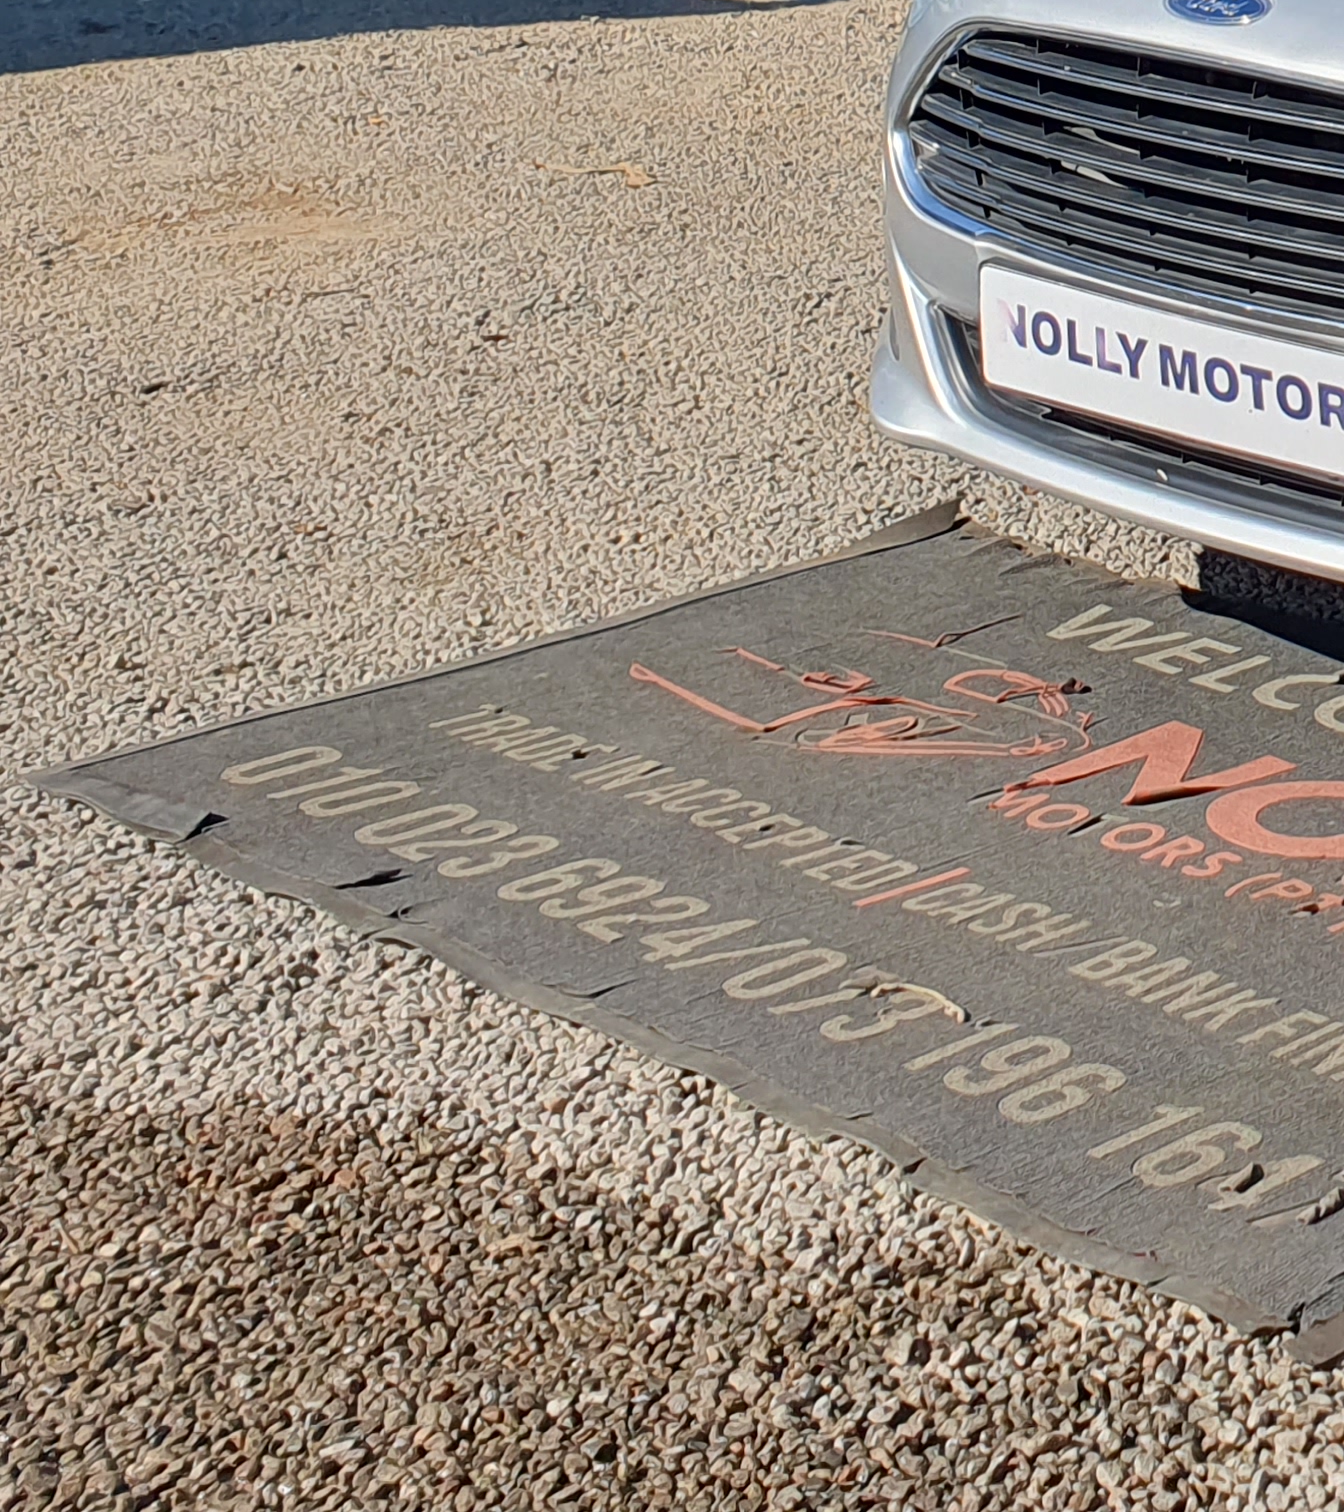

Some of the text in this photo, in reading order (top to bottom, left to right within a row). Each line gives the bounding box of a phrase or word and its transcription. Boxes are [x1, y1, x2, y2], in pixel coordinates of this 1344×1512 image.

[428, 704, 619, 772] TRADE
[988, 781, 1242, 879] MOTORS
[219, 745, 424, 818] 010
[353, 802, 561, 879] 023
[903, 1016, 1128, 1124] 196
